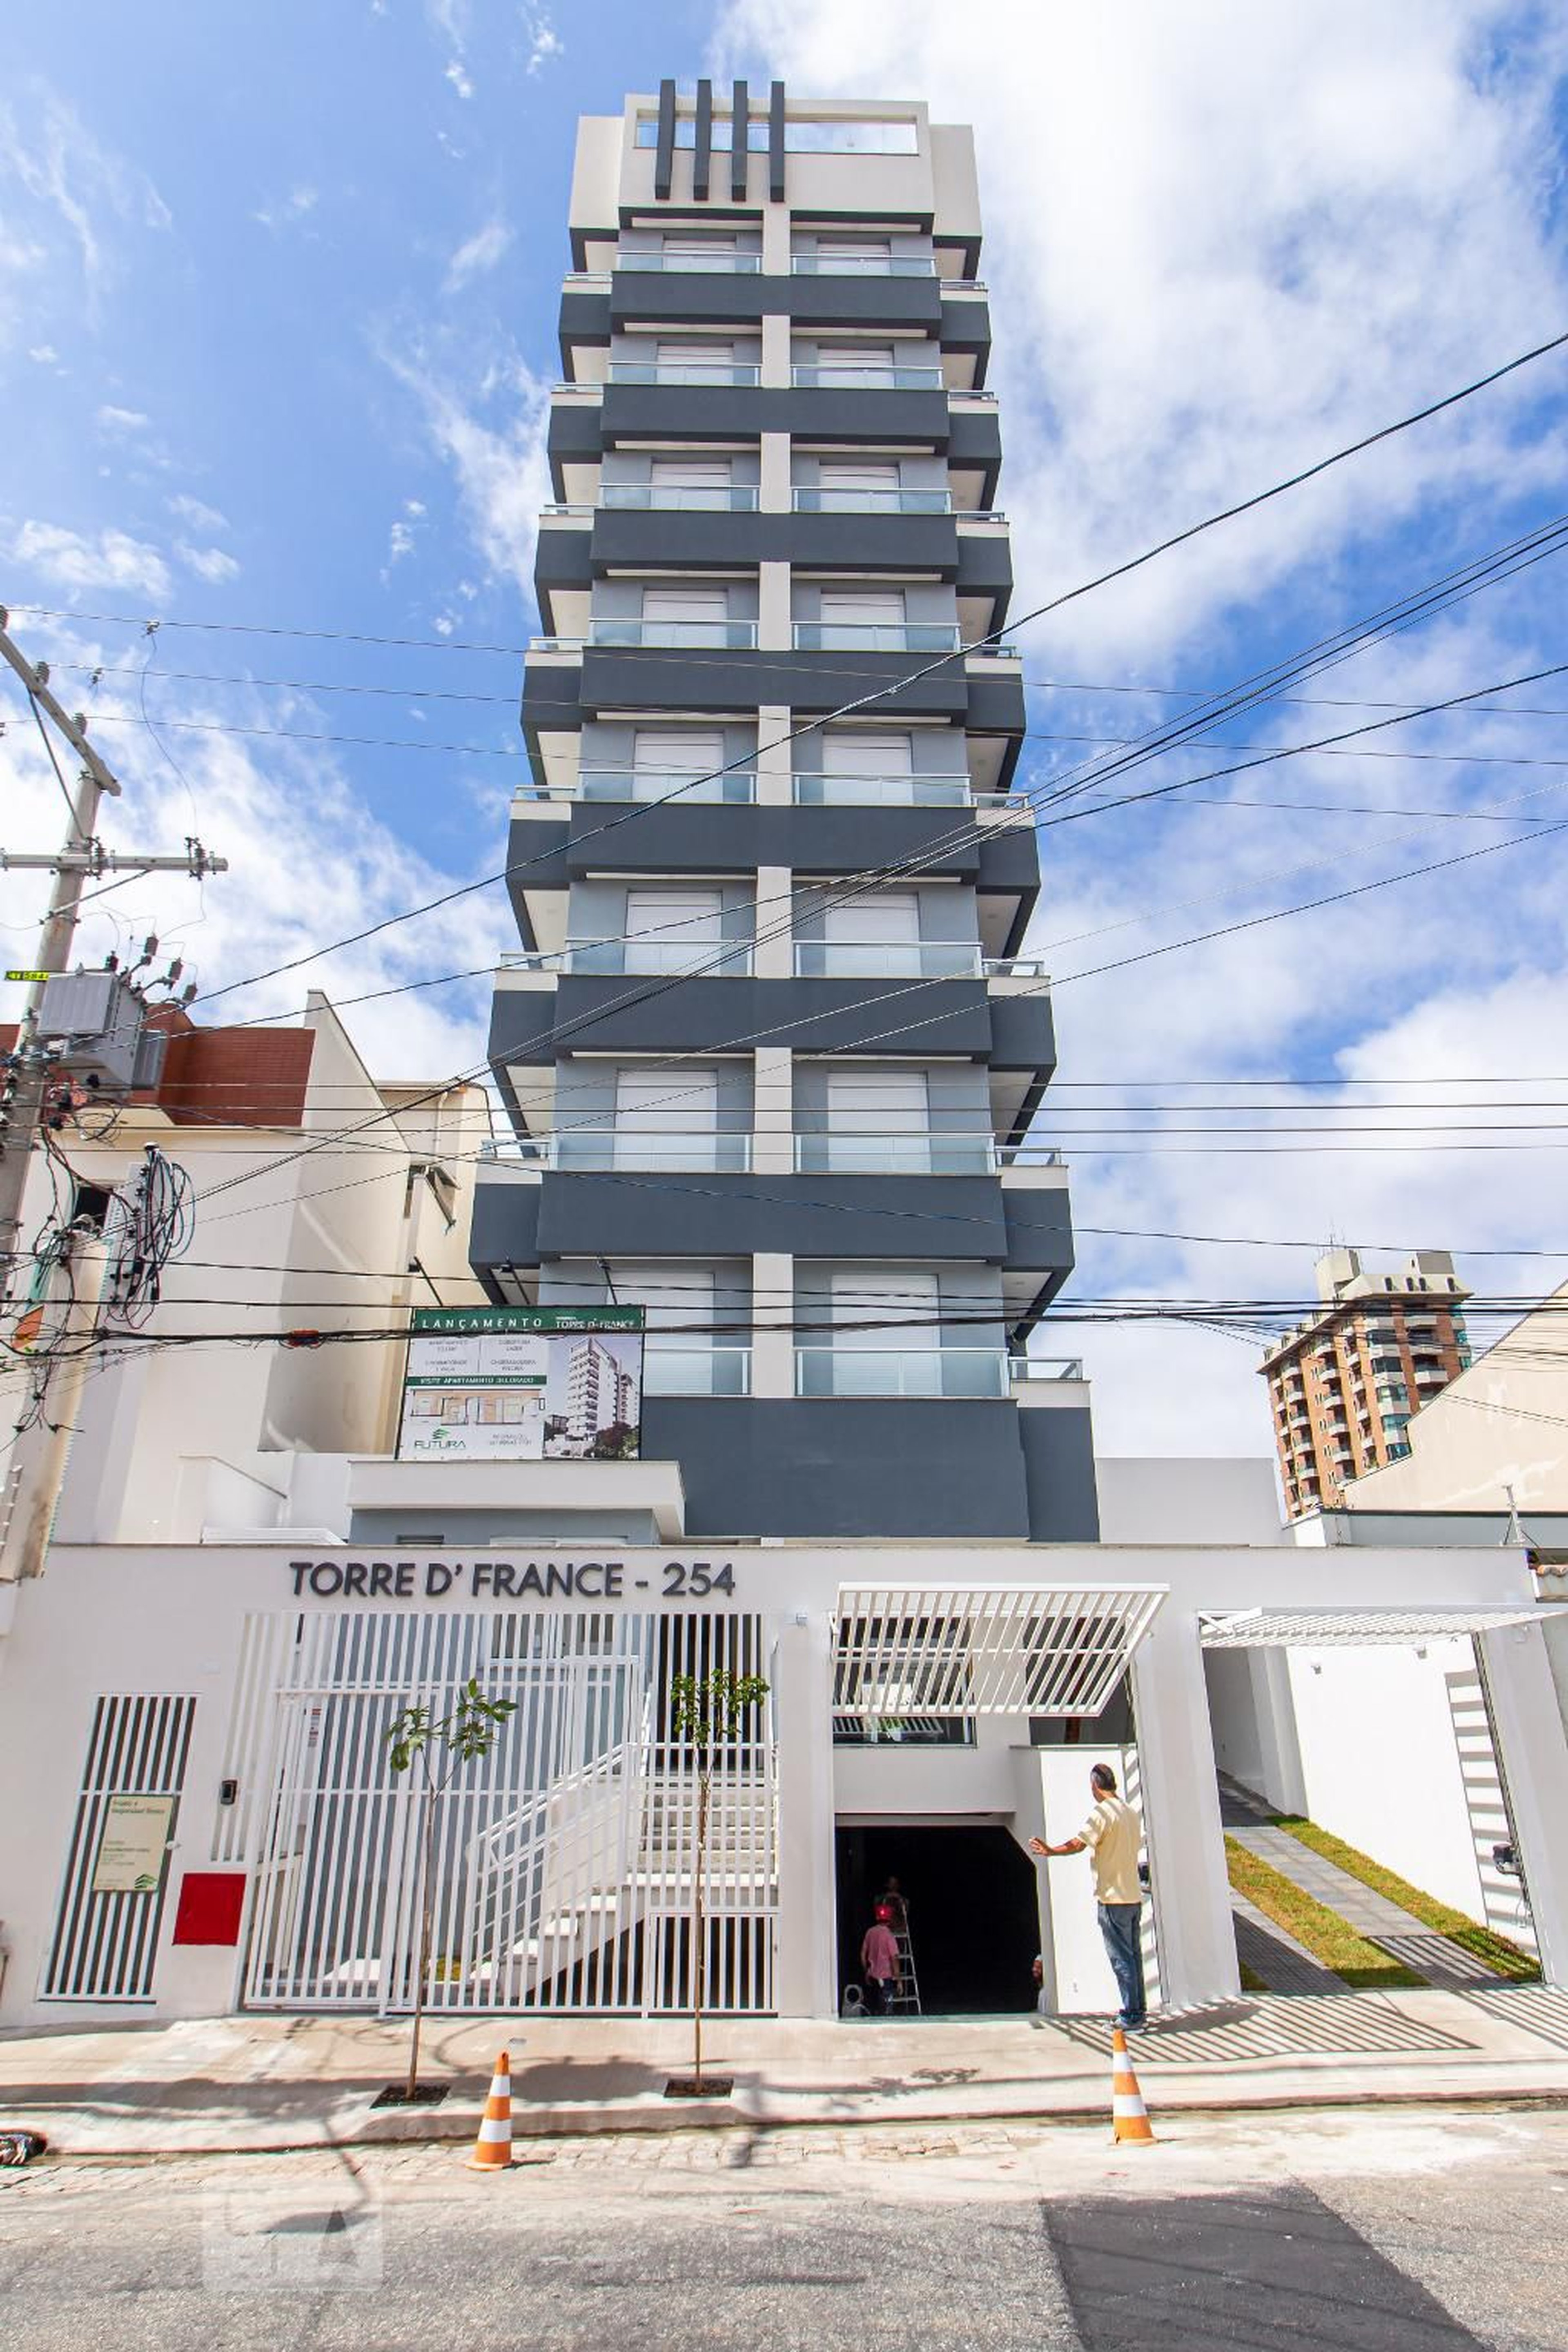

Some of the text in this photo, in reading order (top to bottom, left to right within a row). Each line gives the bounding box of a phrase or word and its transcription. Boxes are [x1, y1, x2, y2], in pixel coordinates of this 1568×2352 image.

[422, 1318, 542, 1331] LANÇAMENTO
[414, 1440, 466, 1449] FUTURA
[289, 1561, 416, 1597] TORRE
[472, 1563, 624, 1597] FRANCE
[662, 1562, 735, 1597] 254
